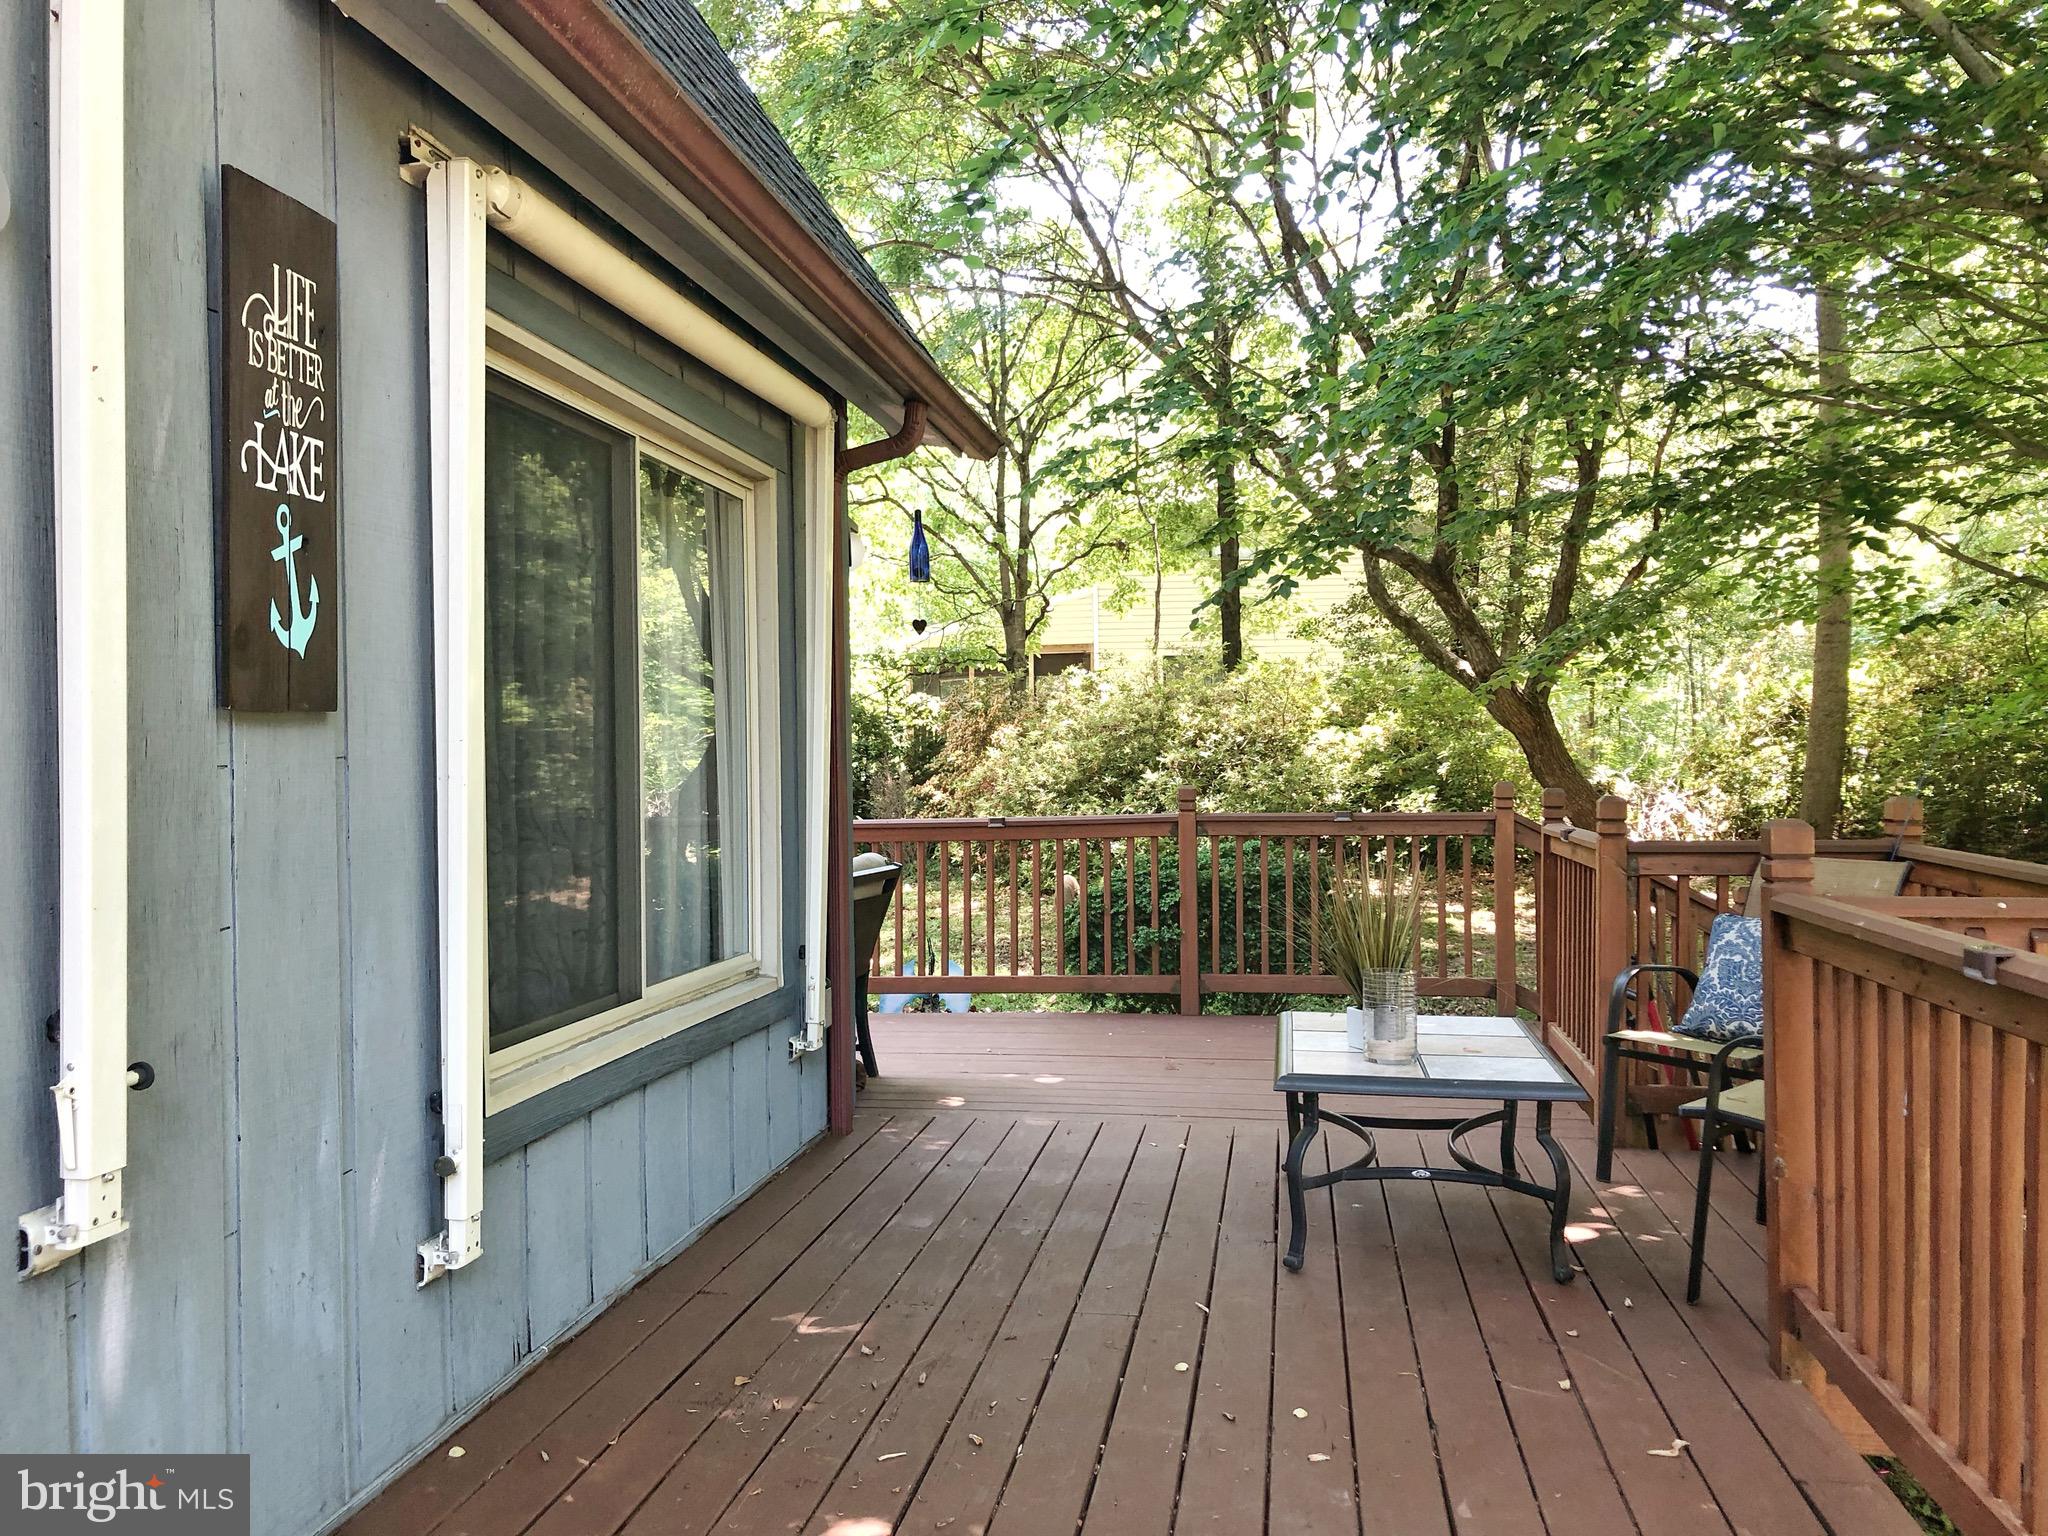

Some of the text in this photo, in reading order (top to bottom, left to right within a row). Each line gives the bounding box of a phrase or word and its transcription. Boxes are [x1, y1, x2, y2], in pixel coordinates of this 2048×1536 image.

[242, 263, 317, 350] LIFE
[247, 327, 325, 393] IS BETTER
[264, 377, 325, 430] at the
[240, 420, 326, 503] LAKE
